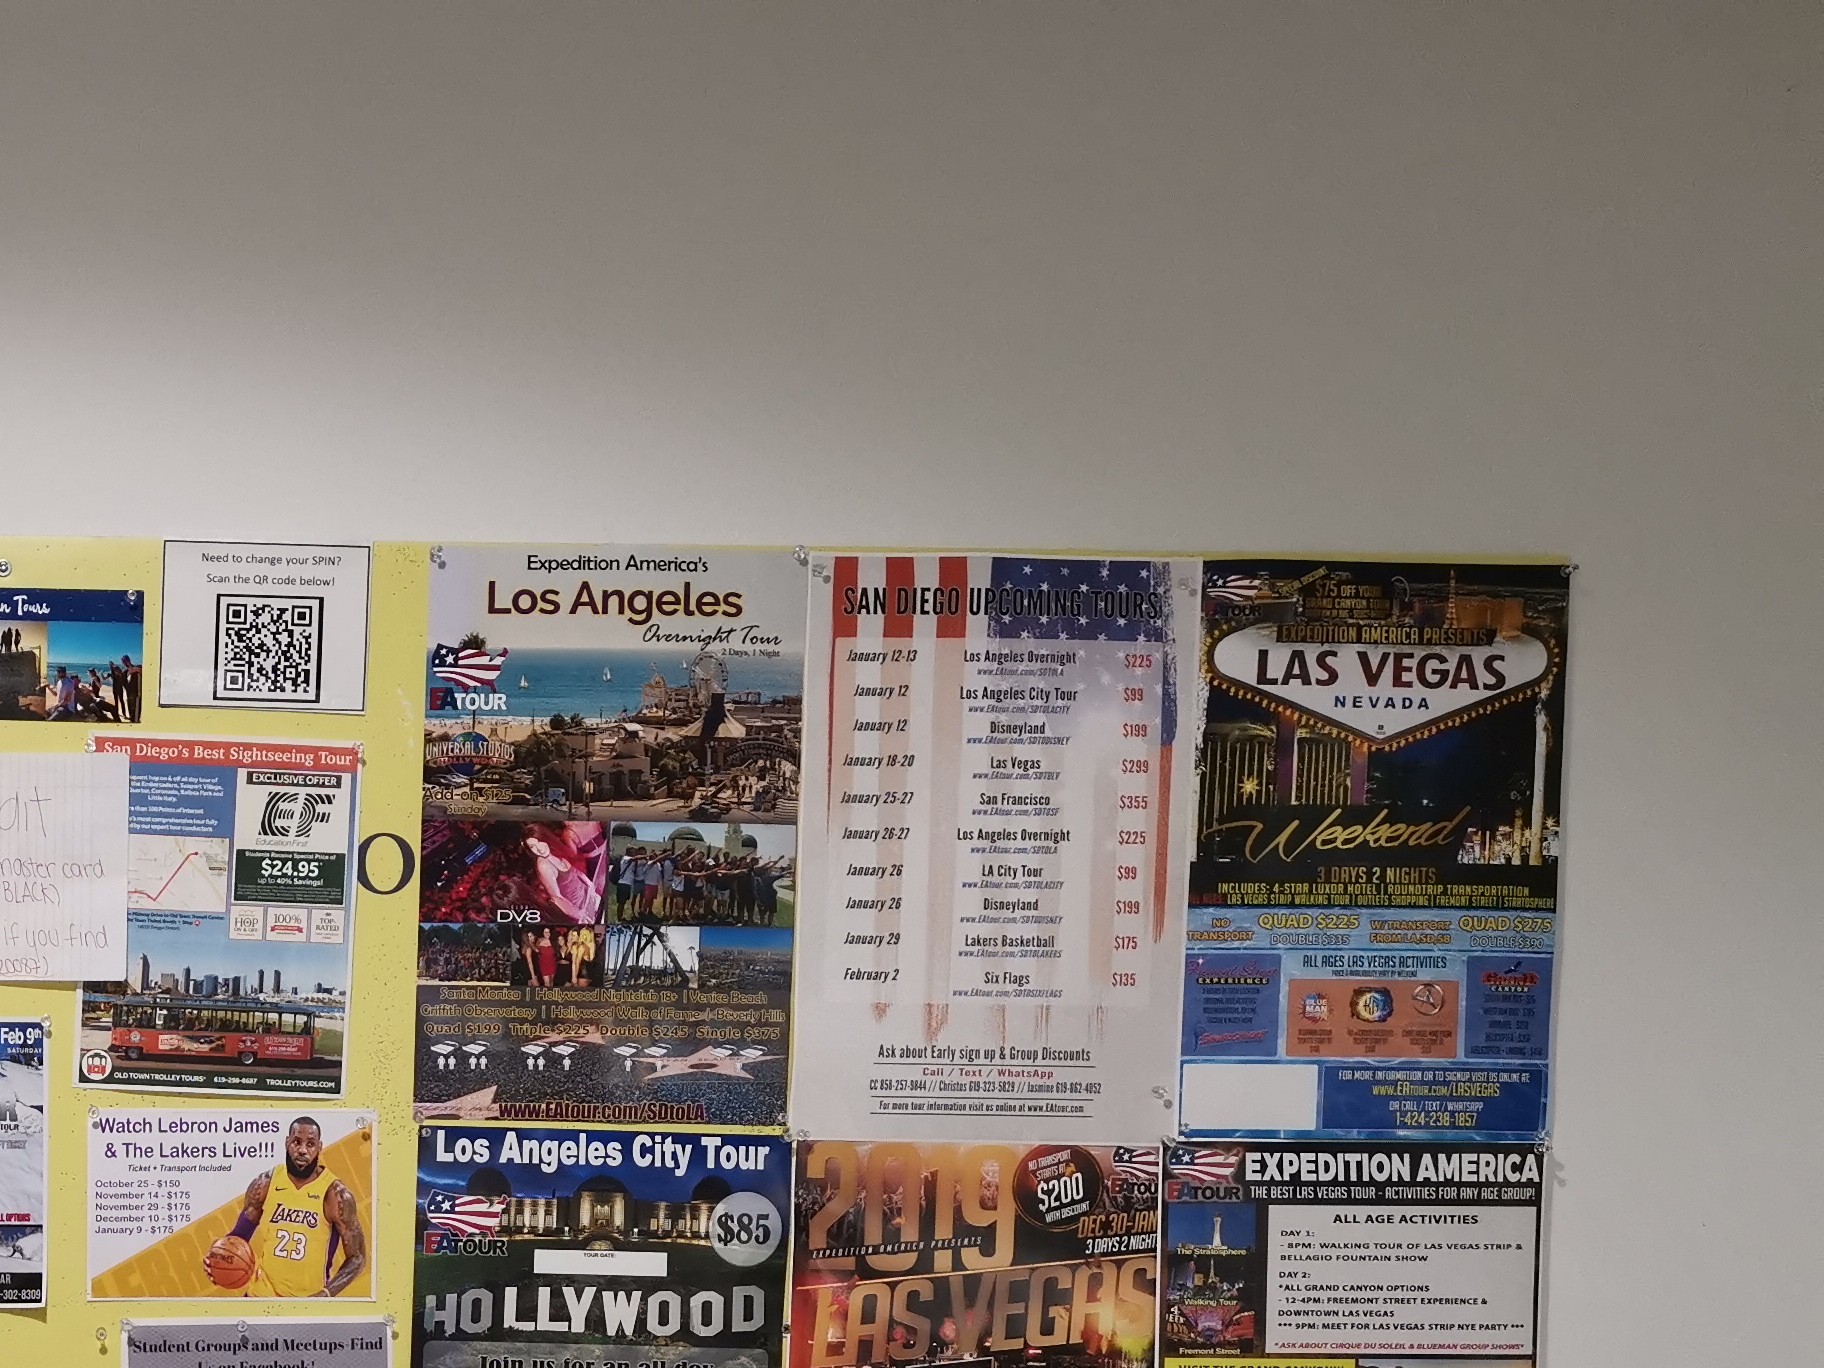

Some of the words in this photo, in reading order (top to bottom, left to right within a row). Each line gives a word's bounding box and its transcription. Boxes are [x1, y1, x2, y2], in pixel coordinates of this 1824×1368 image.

[201, 552, 229, 565] Need
[233, 553, 243, 565] to
[246, 553, 280, 568] change
[284, 557, 307, 569] your
[311, 554, 342, 567] SPIN?
[527, 554, 621, 573] Expedition
[626, 556, 708, 573] America's
[206, 573, 229, 584] Scan
[233, 573, 249, 585] the
[253, 575, 268, 587] QR
[271, 574, 295, 586] code
[298, 575, 335, 587] below!
[13, 595, 50, 616] Tours
[487, 581, 565, 617] Los
[569, 582, 743, 624] Angeles
[843, 587, 887, 616] SAN
[896, 587, 960, 617] DIEGO
[969, 588, 1083, 618] UPCOMING
[1089, 590, 1162, 620] TOURS
[642, 623, 735, 647] Overnight
[739, 625, 782, 646] Tour
[846, 649, 888, 665] January
[890, 650, 917, 663] 12-13
[964, 650, 981, 664] Los
[985, 650, 1024, 667] Angeles
[1027, 650, 1077, 667] Overnight
[1125, 654, 1152, 669] $225
[1255, 649, 1349, 687] LAS
[1358, 652, 1508, 691] VEGAS
[1333, 695, 1432, 711] NEVADA
[990, 721, 1047, 738] Disneyland
[1123, 723, 1147, 738] $199
[103, 741, 131, 758] San
[135, 742, 190, 761] Diego's
[194, 744, 224, 761] Best
[229, 745, 314, 767] Sightseeing
[318, 750, 353, 766] Tour
[252, 773, 301, 786] EXCLUSIVE
[304, 775, 337, 787] OFFER
[1203, 805, 1472, 863] Weekend
[0, 1027, 23, 1044] Feb
[26, 1027, 42, 1046] 9th
[498, 1101, 706, 1122] www.EAtour.com/SDtoLA
[1395, 1111, 1477, 1128] 1-424-238-1857
[98, 1116, 153, 1135] Watch
[157, 1117, 216, 1135] Lebron
[222, 1117, 280, 1135] James
[105, 1143, 118, 1159] &
[121, 1142, 155, 1159] The
[161, 1142, 217, 1159] Lakers
[222, 1142, 275, 1159] Live!!!
[435, 1130, 491, 1164] Los
[499, 1131, 624, 1174] Angeles
[632, 1133, 693, 1176] City
[701, 1136, 770, 1170] Tour
[1245, 1152, 1412, 1183] EXPEDITION
[1415, 1153, 1540, 1183] AMERICA
[1037, 1173, 1084, 1212] $200
[269, 1203, 319, 1228] LAKERS
[805, 1143, 1019, 1272] 2019
[1332, 1213, 1358, 1225] ALL
[1362, 1213, 1391, 1226] AGE
[1395, 1213, 1479, 1226] ACTIVITIES
[717, 1212, 771, 1249] $85
[274, 1229, 306, 1262] 23
[424, 1285, 765, 1336] HOLLYWOOD
[133, 1337, 192, 1355] Student
[195, 1337, 248, 1357] Groups
[251, 1338, 279, 1353] and
